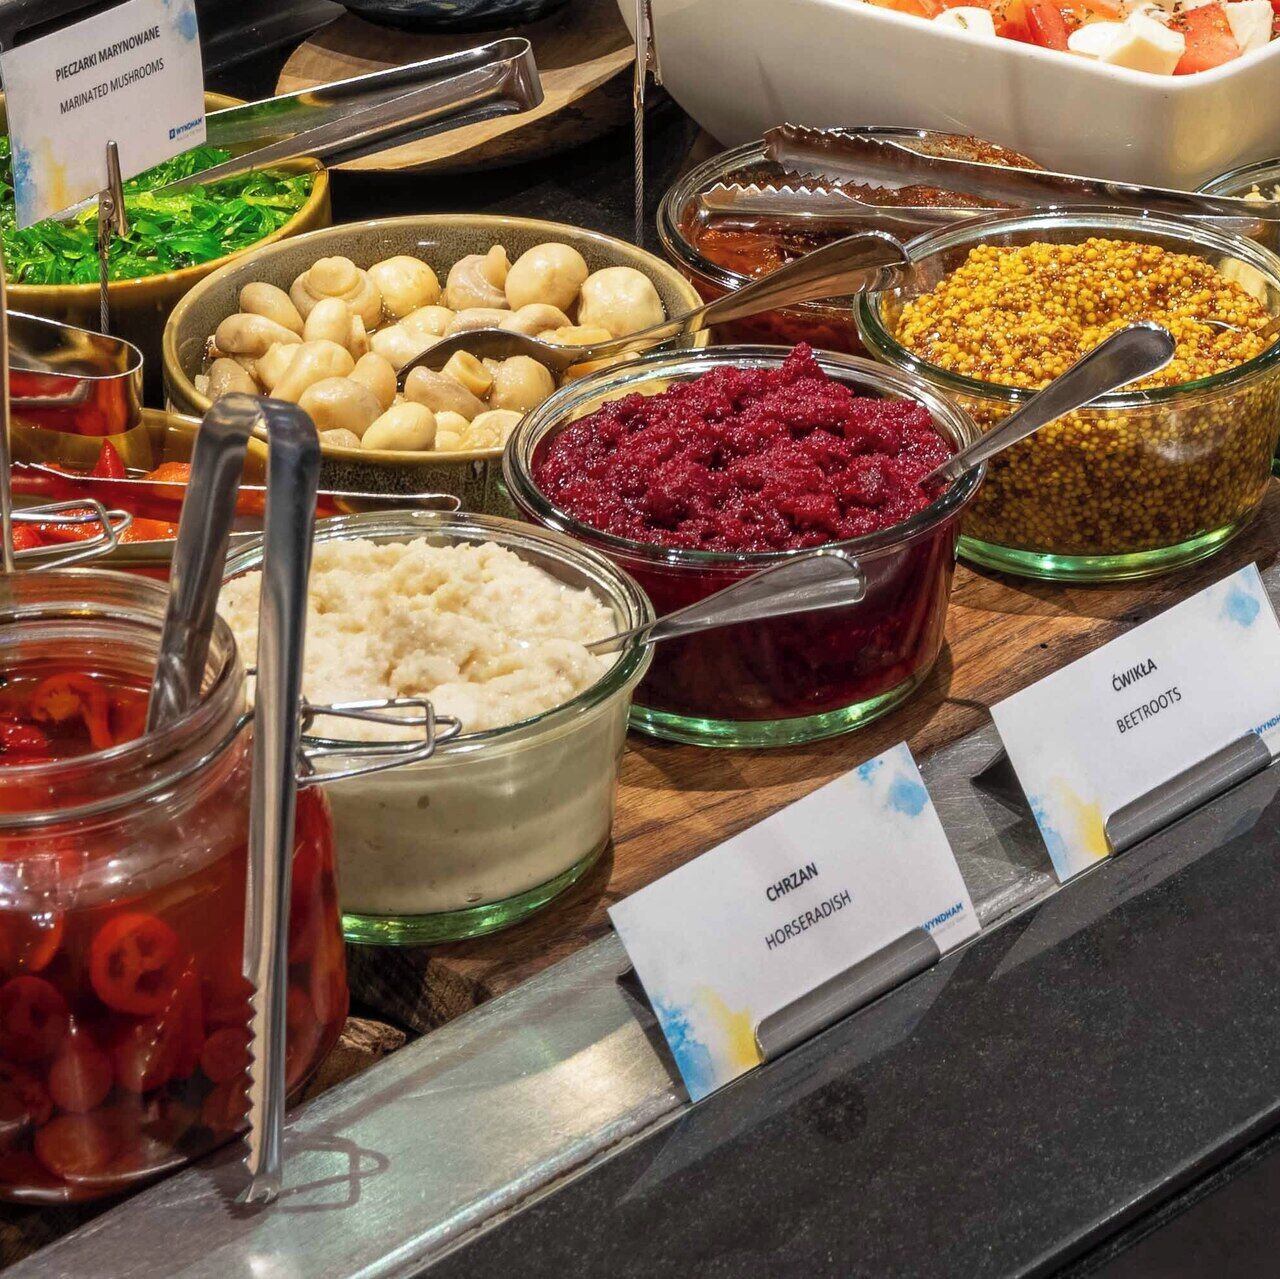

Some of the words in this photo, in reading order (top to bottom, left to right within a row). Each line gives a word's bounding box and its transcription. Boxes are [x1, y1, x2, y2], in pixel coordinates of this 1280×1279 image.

[55, 53, 98, 82] PIECZARKI
[98, 25, 161, 62] MARYNOWANE
[59, 83, 109, 115] MARINATED
[110, 57, 165, 92] MUSHROOMS
[1112, 658, 1158, 692] ĆWIKŁA
[1116, 686, 1182, 734] BEETROOTS
[766, 862, 819, 902] CHRZAN
[764, 889, 852, 950] HORSERADISH
